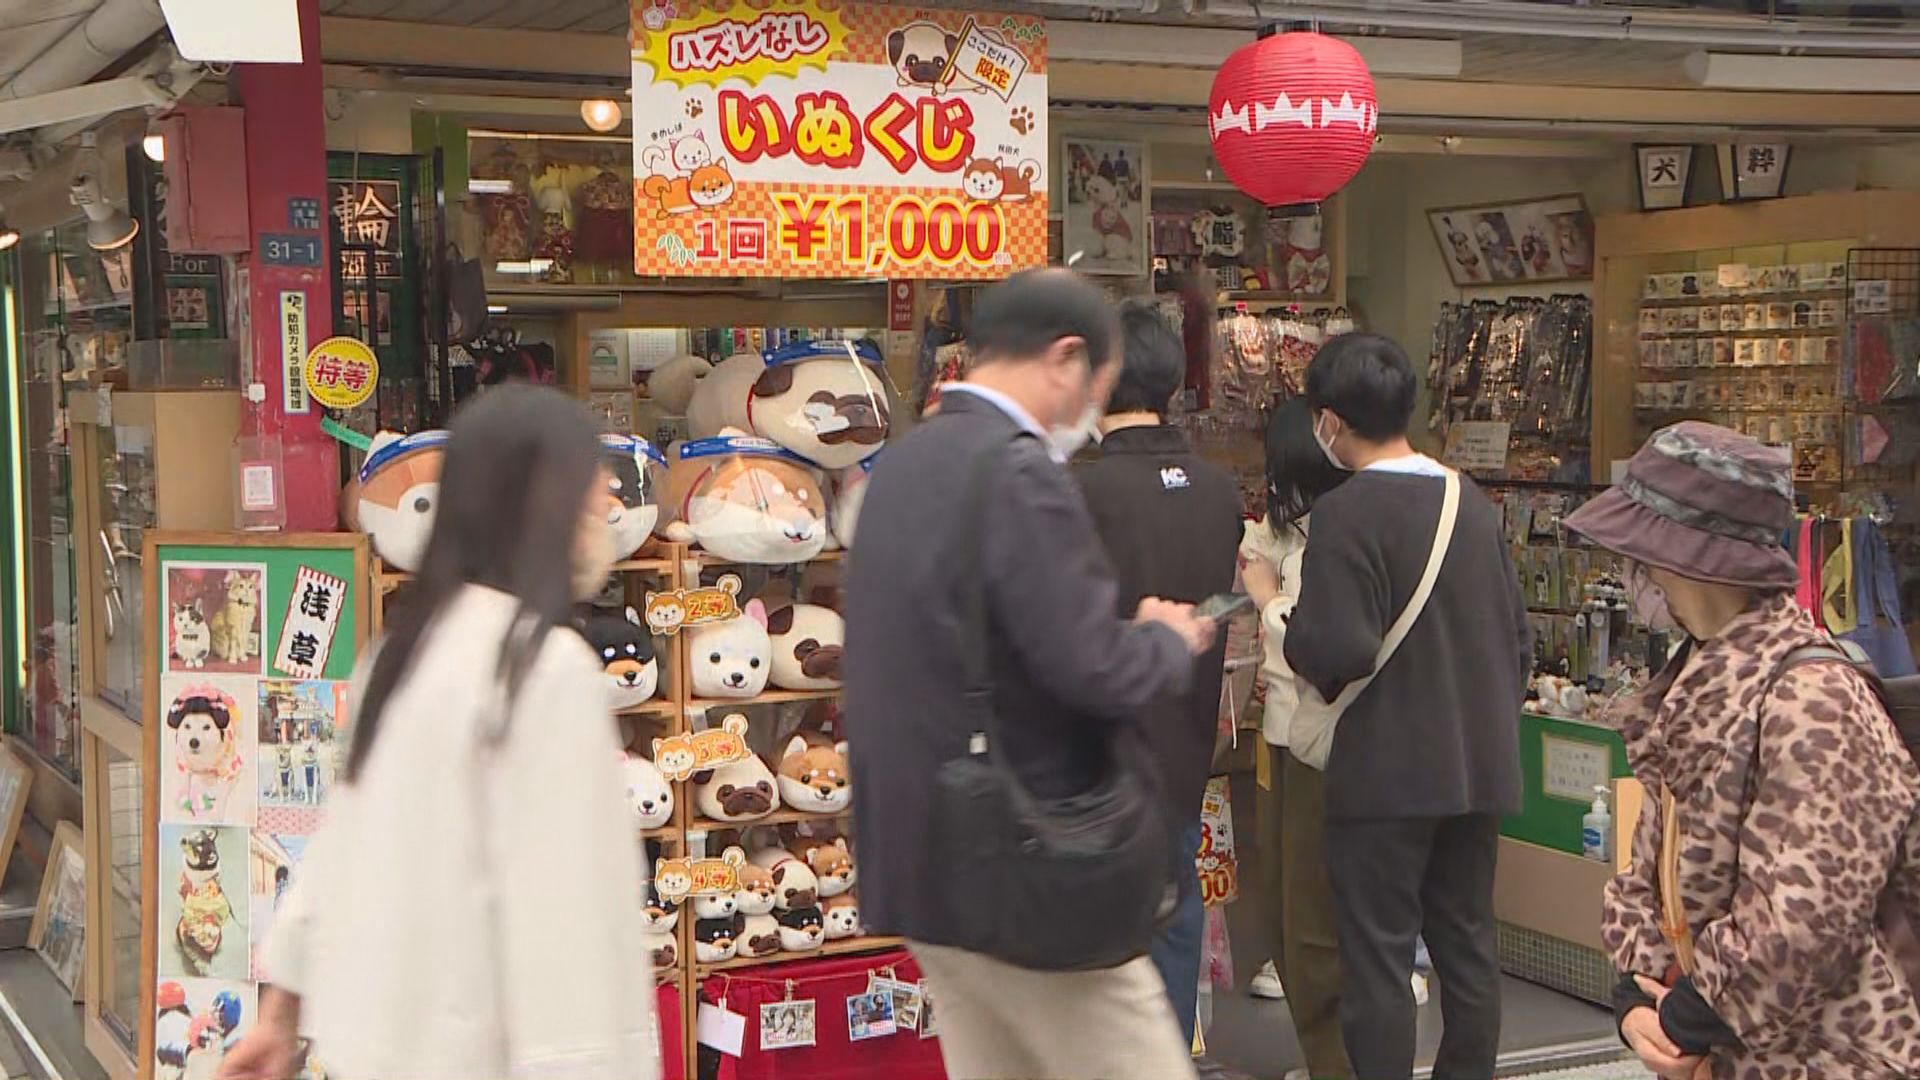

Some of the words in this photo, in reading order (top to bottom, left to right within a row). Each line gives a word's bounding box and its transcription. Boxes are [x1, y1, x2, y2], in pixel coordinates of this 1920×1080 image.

[671, 13, 829, 71] ハズレなし
[974, 57, 1010, 91] 限定
[718, 90, 975, 174] いぬくじ
[1651, 157, 1677, 183] 犬
[333, 184, 397, 248] 輪
[694, 218, 768, 262] 1回
[771, 193, 1004, 272] ¥1,000
[170, 254, 208, 273] For
[268, 241, 315, 260] 31-1
[314, 355, 370, 392] 特等
[288, 582, 331, 667] 浅草
